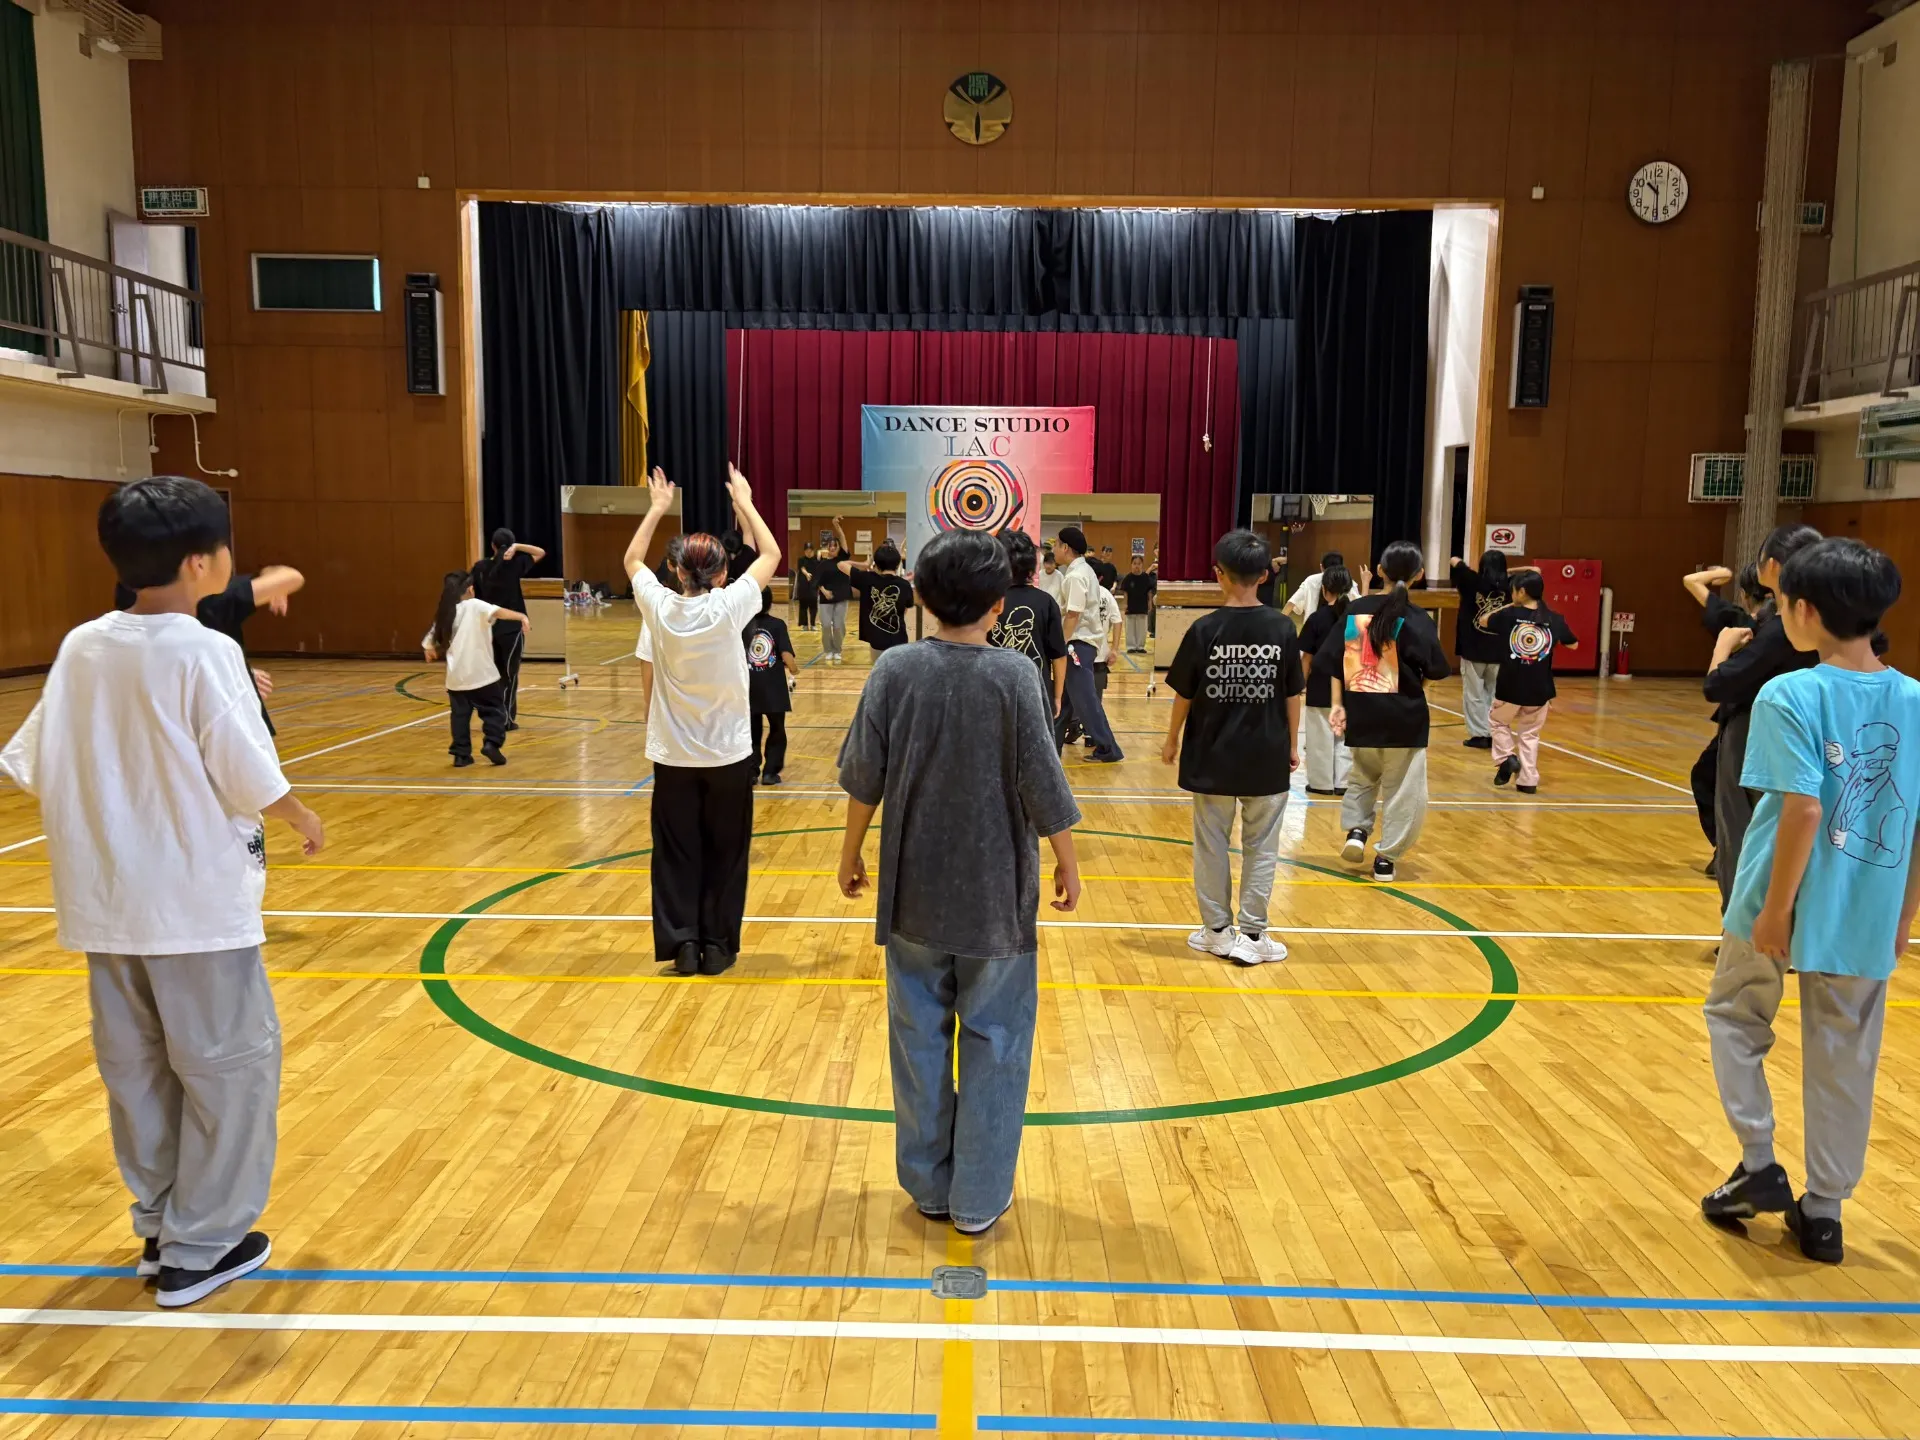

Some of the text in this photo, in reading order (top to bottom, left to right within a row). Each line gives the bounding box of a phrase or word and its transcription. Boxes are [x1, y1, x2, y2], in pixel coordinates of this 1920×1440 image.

[1635, 178, 1645, 188] 10
[1672, 177, 1679, 187] 2
[1632, 188, 1640, 198] 9
[1673, 187, 1681, 198] 3
[1635, 198, 1643, 208] 8
[1669, 198, 1677, 208] 4
[1643, 206, 1650, 215] 7
[884, 416, 1070, 433] DANCE STUDIO
[944, 435, 1012, 457] LAC
[1209, 644, 1282, 661] OUTDOOR
[1206, 664, 1278, 679] OUTDOOR
[1205, 683, 1275, 699] OUTDOOR
